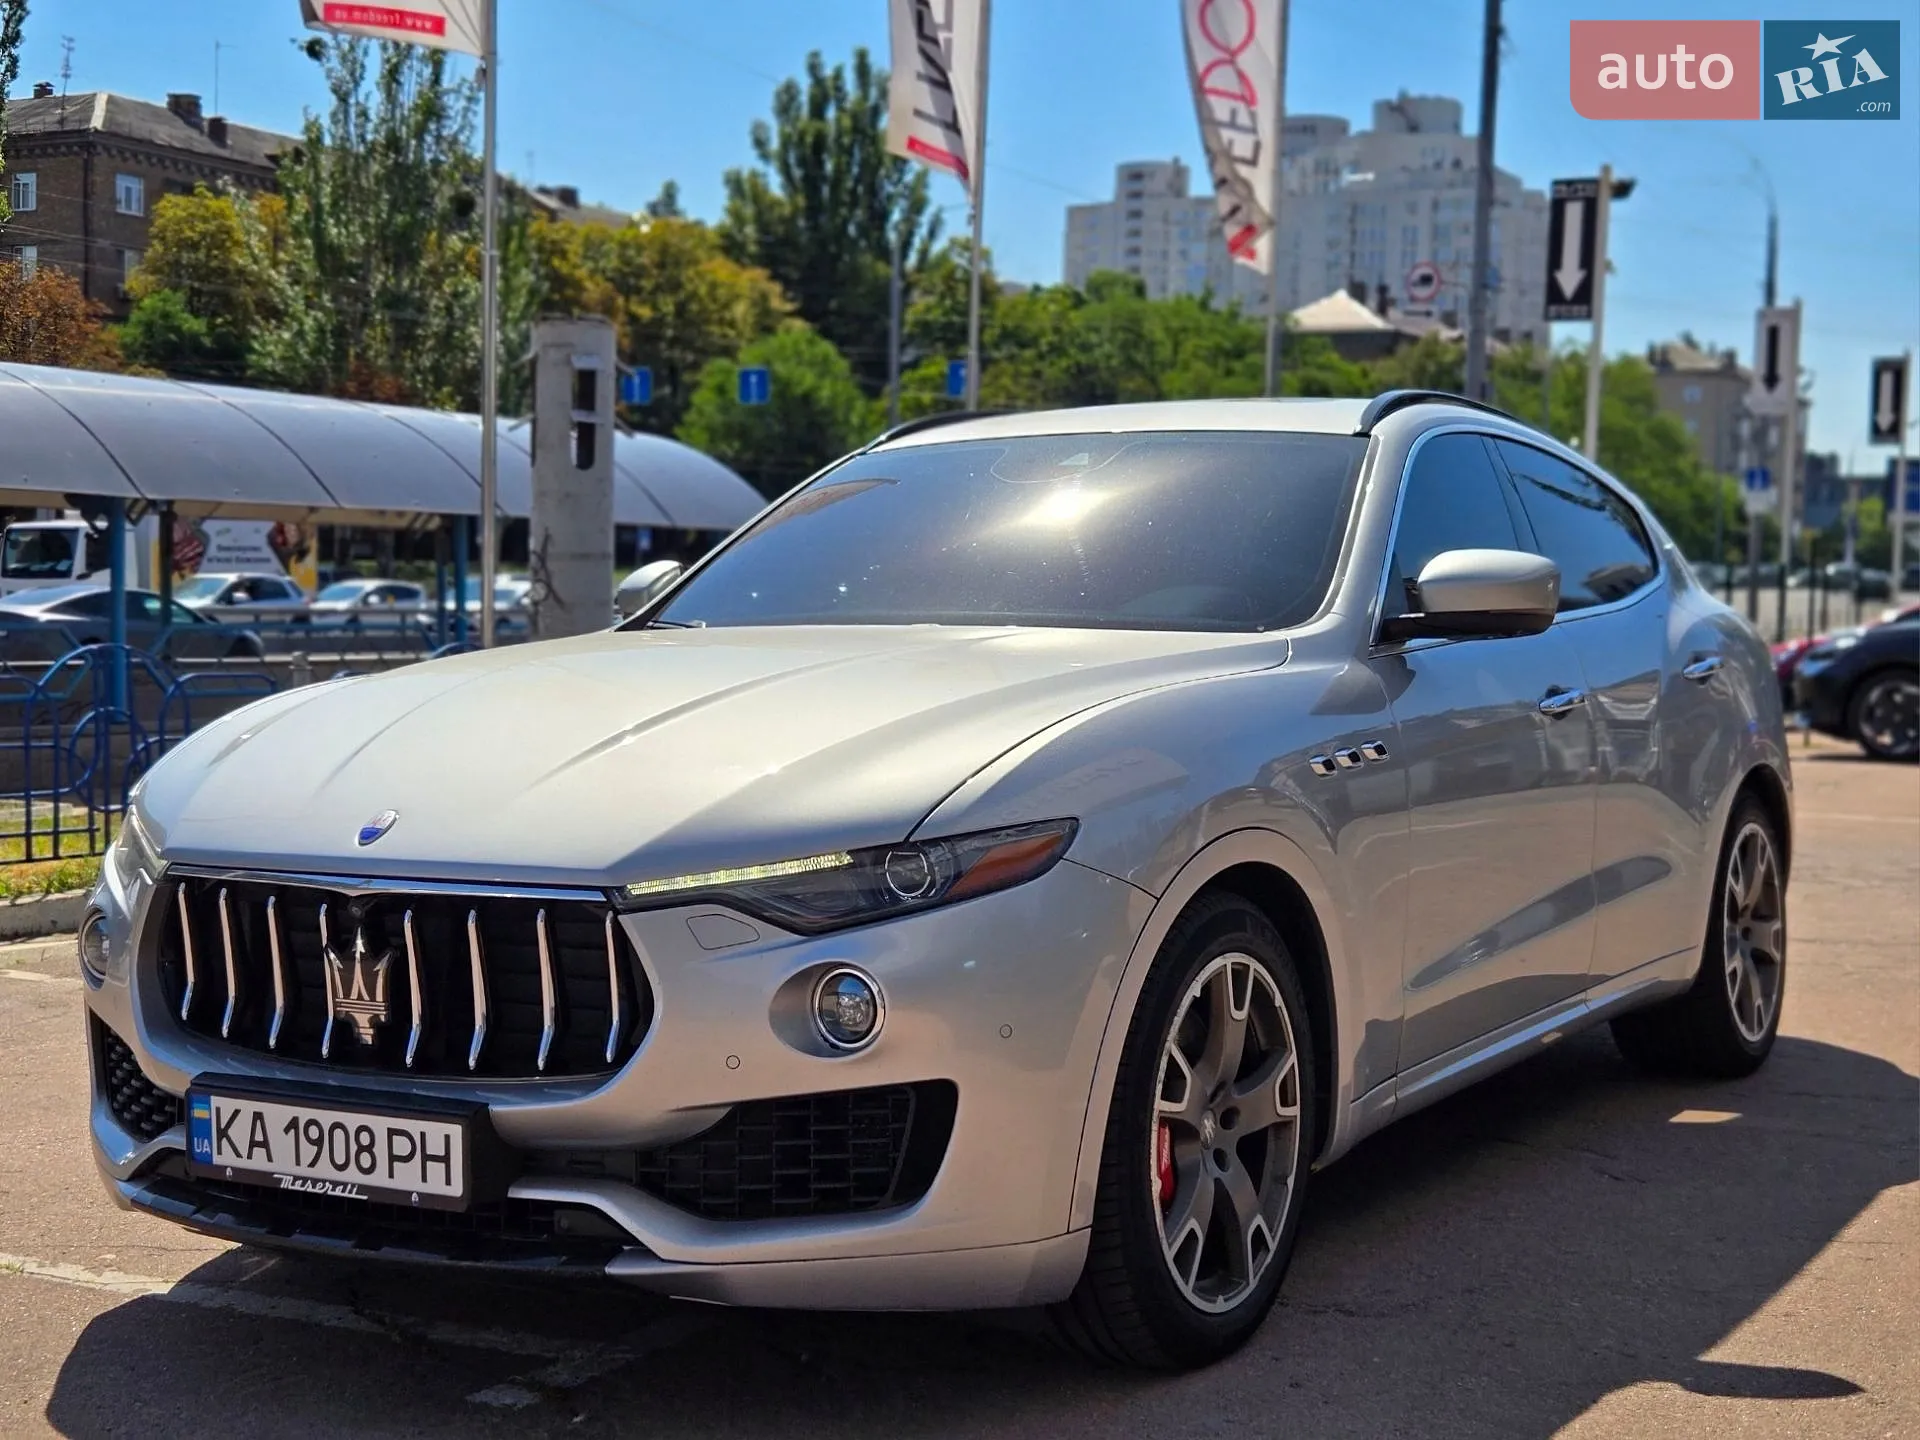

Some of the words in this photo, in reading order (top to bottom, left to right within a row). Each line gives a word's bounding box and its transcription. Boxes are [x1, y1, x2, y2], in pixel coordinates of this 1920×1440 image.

[194, 1137, 211, 1154] UA
[215, 1106, 273, 1163] KA
[283, 1115, 377, 1175] 1908
[387, 1127, 452, 1187] PH
